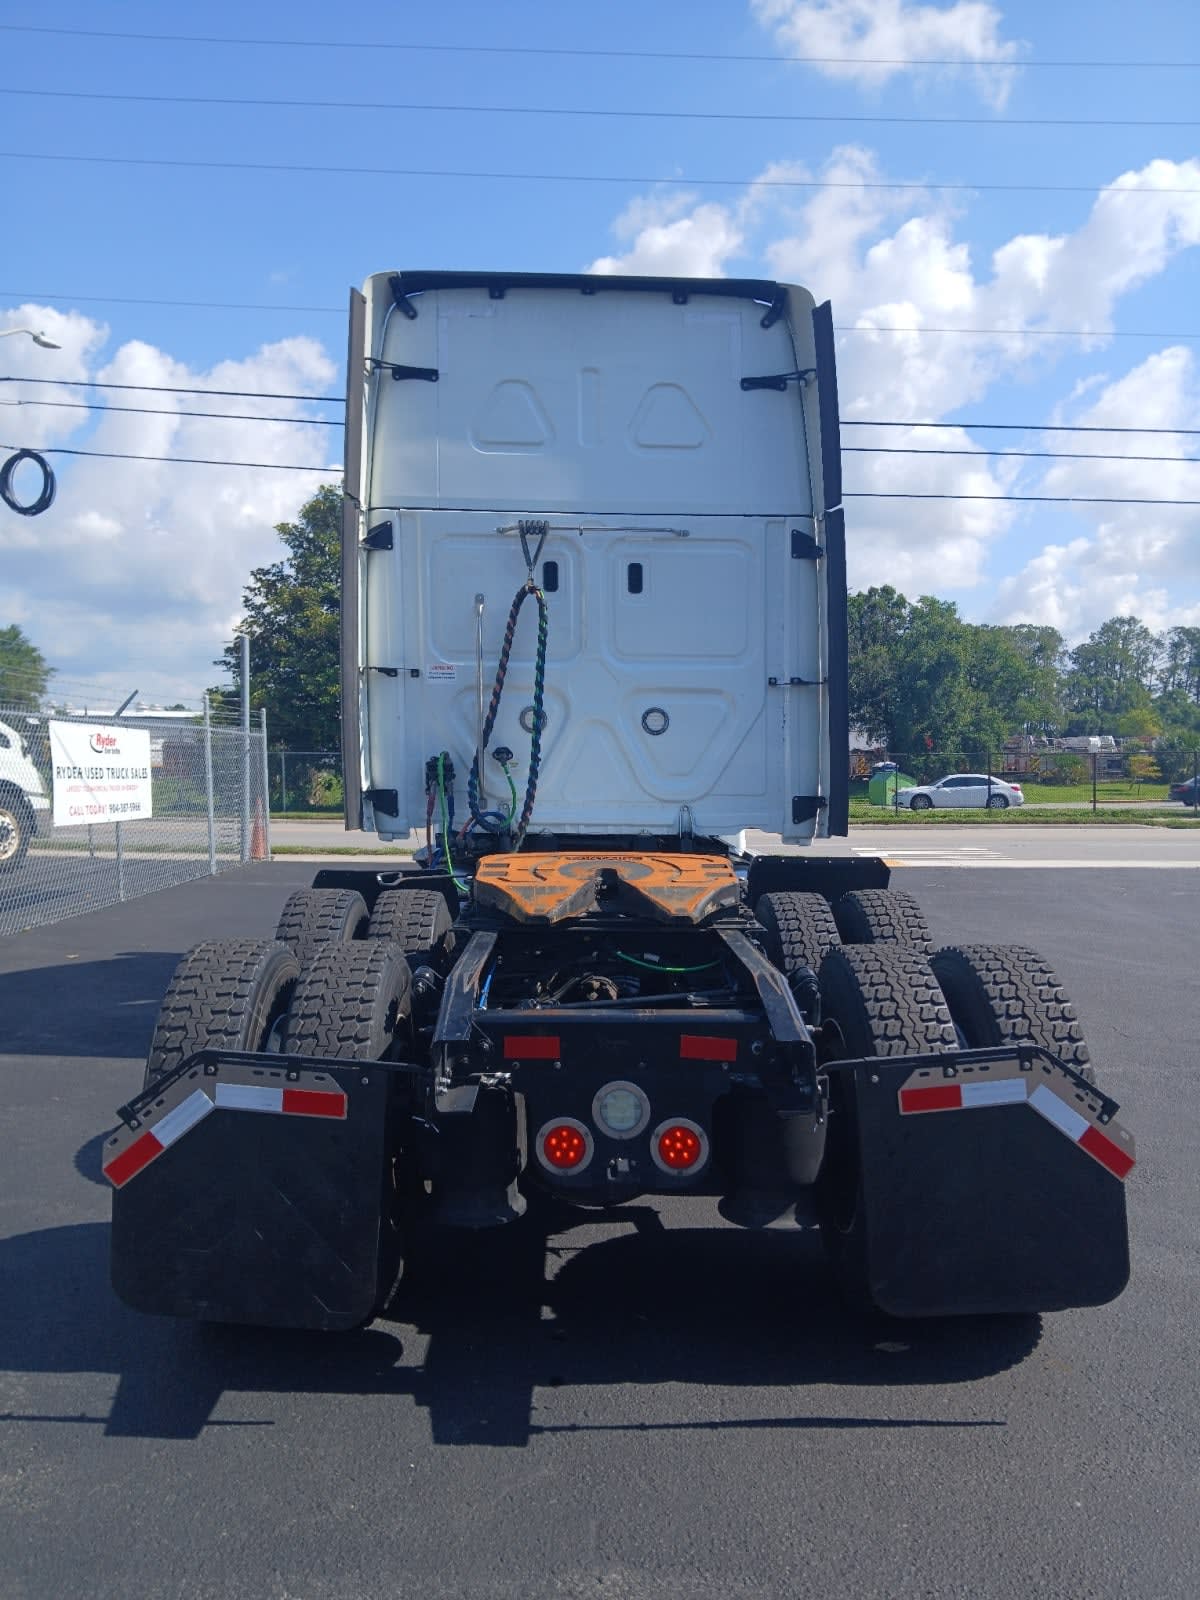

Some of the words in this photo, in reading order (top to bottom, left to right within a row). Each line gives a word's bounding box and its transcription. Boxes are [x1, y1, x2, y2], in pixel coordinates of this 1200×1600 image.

[96, 733, 117, 749] Ryder
[56, 766, 83, 779] RYDER
[84, 767, 105, 780] USED
[106, 767, 129, 780] TRUCK
[131, 767, 148, 779] SALES
[69, 804, 84, 817] CALL
